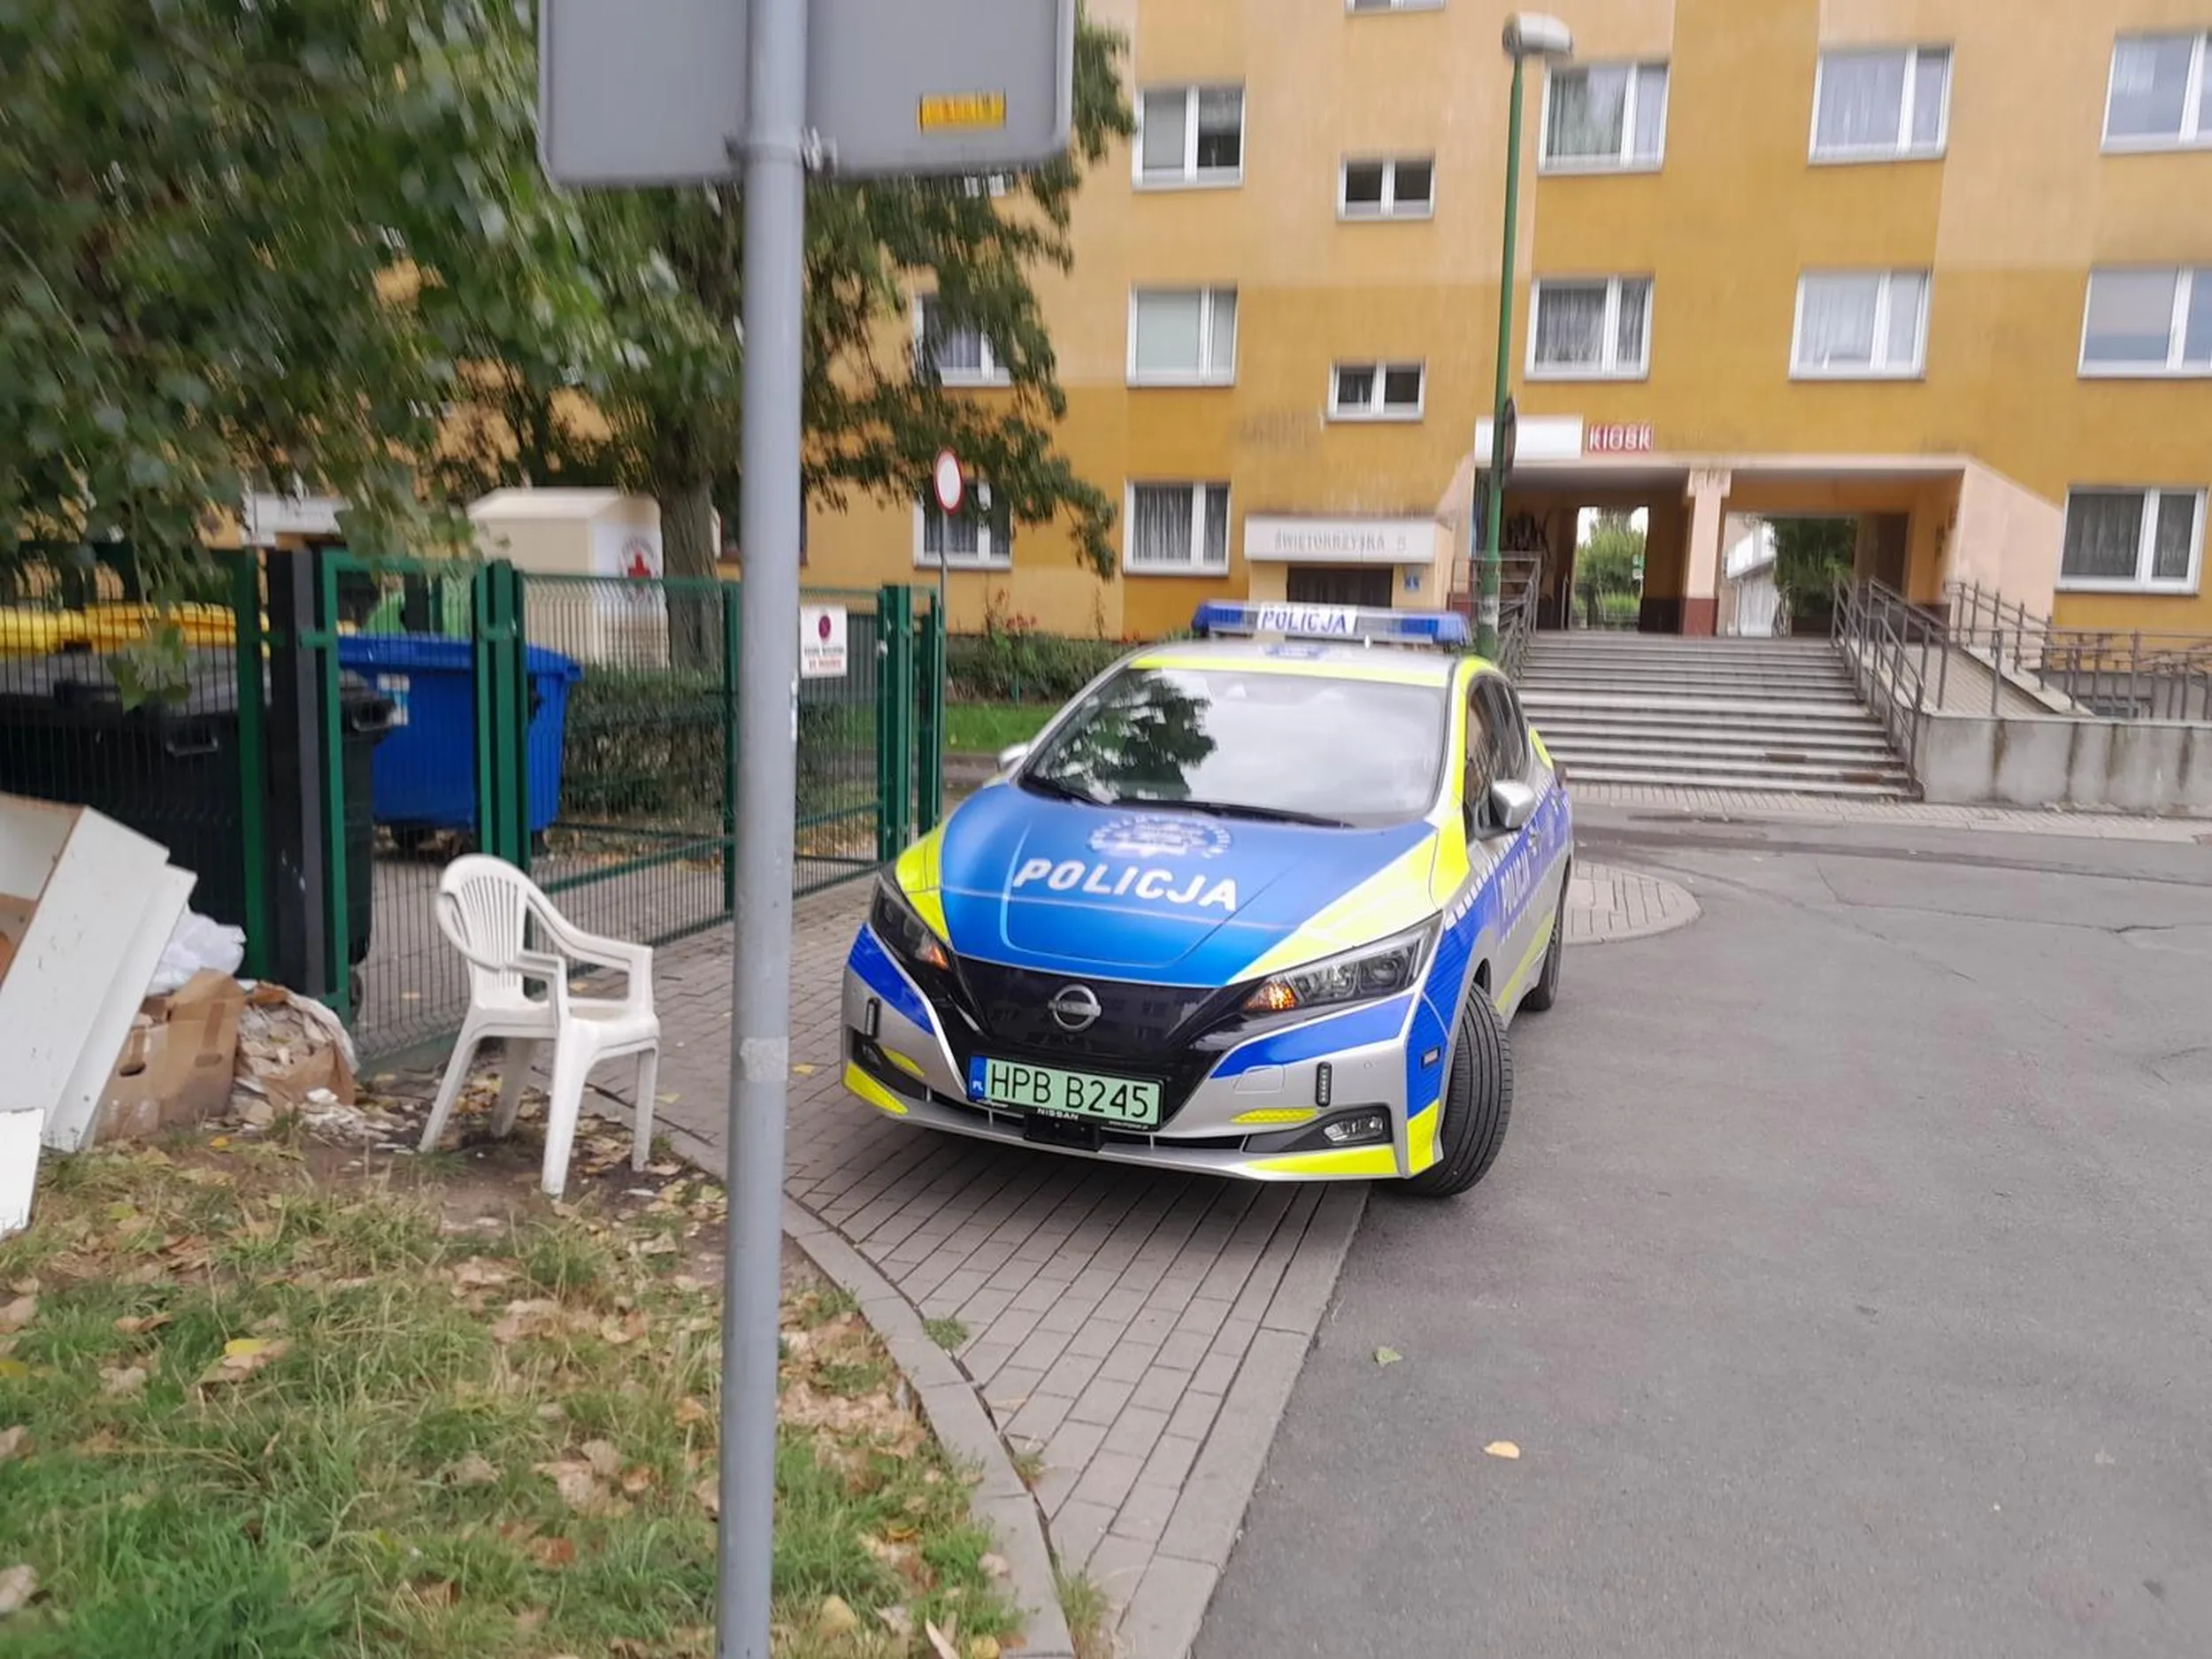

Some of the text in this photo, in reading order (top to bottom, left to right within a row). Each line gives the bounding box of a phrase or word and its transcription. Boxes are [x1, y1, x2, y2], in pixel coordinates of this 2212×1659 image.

[1589, 424, 1650, 451] KIOSK
[1262, 611, 1347, 634] POLICJA
[1012, 857, 1237, 911] POLICJA
[973, 1080, 983, 1091] PL
[991, 1064, 1148, 1118] HPB B245
[1037, 1107, 1079, 1121] NISSAN
